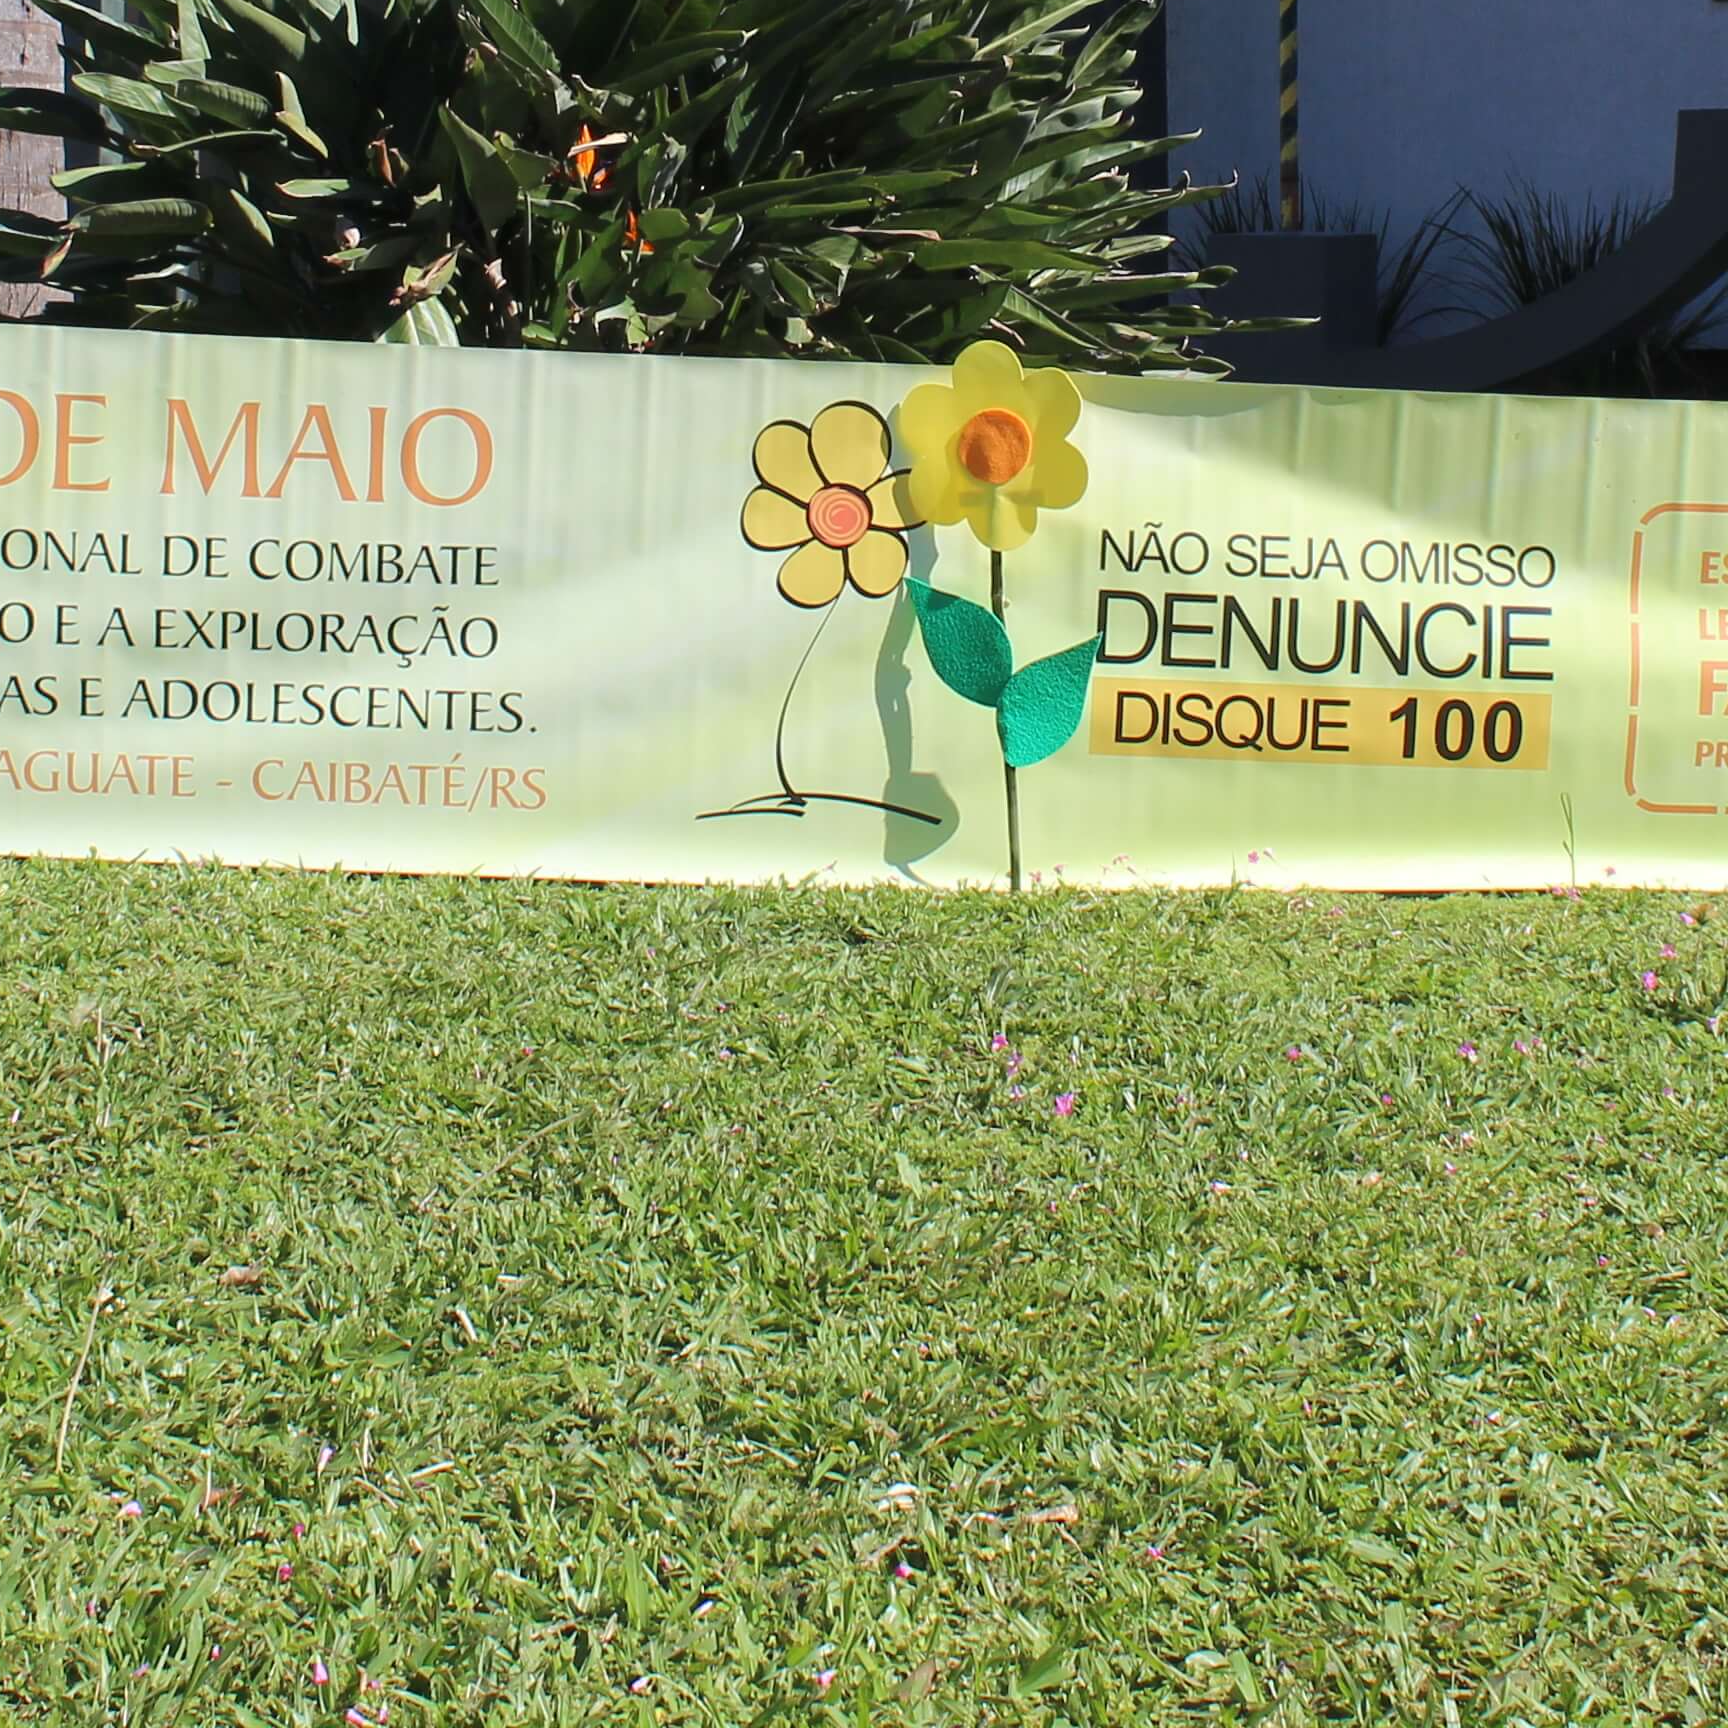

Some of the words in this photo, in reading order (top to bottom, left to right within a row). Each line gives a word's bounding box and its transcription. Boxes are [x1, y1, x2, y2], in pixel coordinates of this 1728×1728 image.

[159, 398, 495, 507] MAIO
[162, 534, 230, 579] DE
[249, 538, 500, 587] COMBATE
[1099, 522, 1210, 575] NÃO
[1225, 533, 1348, 582] SEJA
[1360, 541, 1557, 588] OMISSO
[55, 605, 82, 646] E
[98, 607, 137, 649] A
[153, 604, 500, 669] EXPLORAÇÃO
[1096, 588, 1555, 682] DENUNCIE
[80, 675, 105, 718] E
[123, 677, 539, 734] ADOLESCENTES.
[1115, 691, 1351, 752] DISQUE
[1389, 697, 1524, 763] 100
[252, 752, 548, 815] CAIBATÉ/RS
